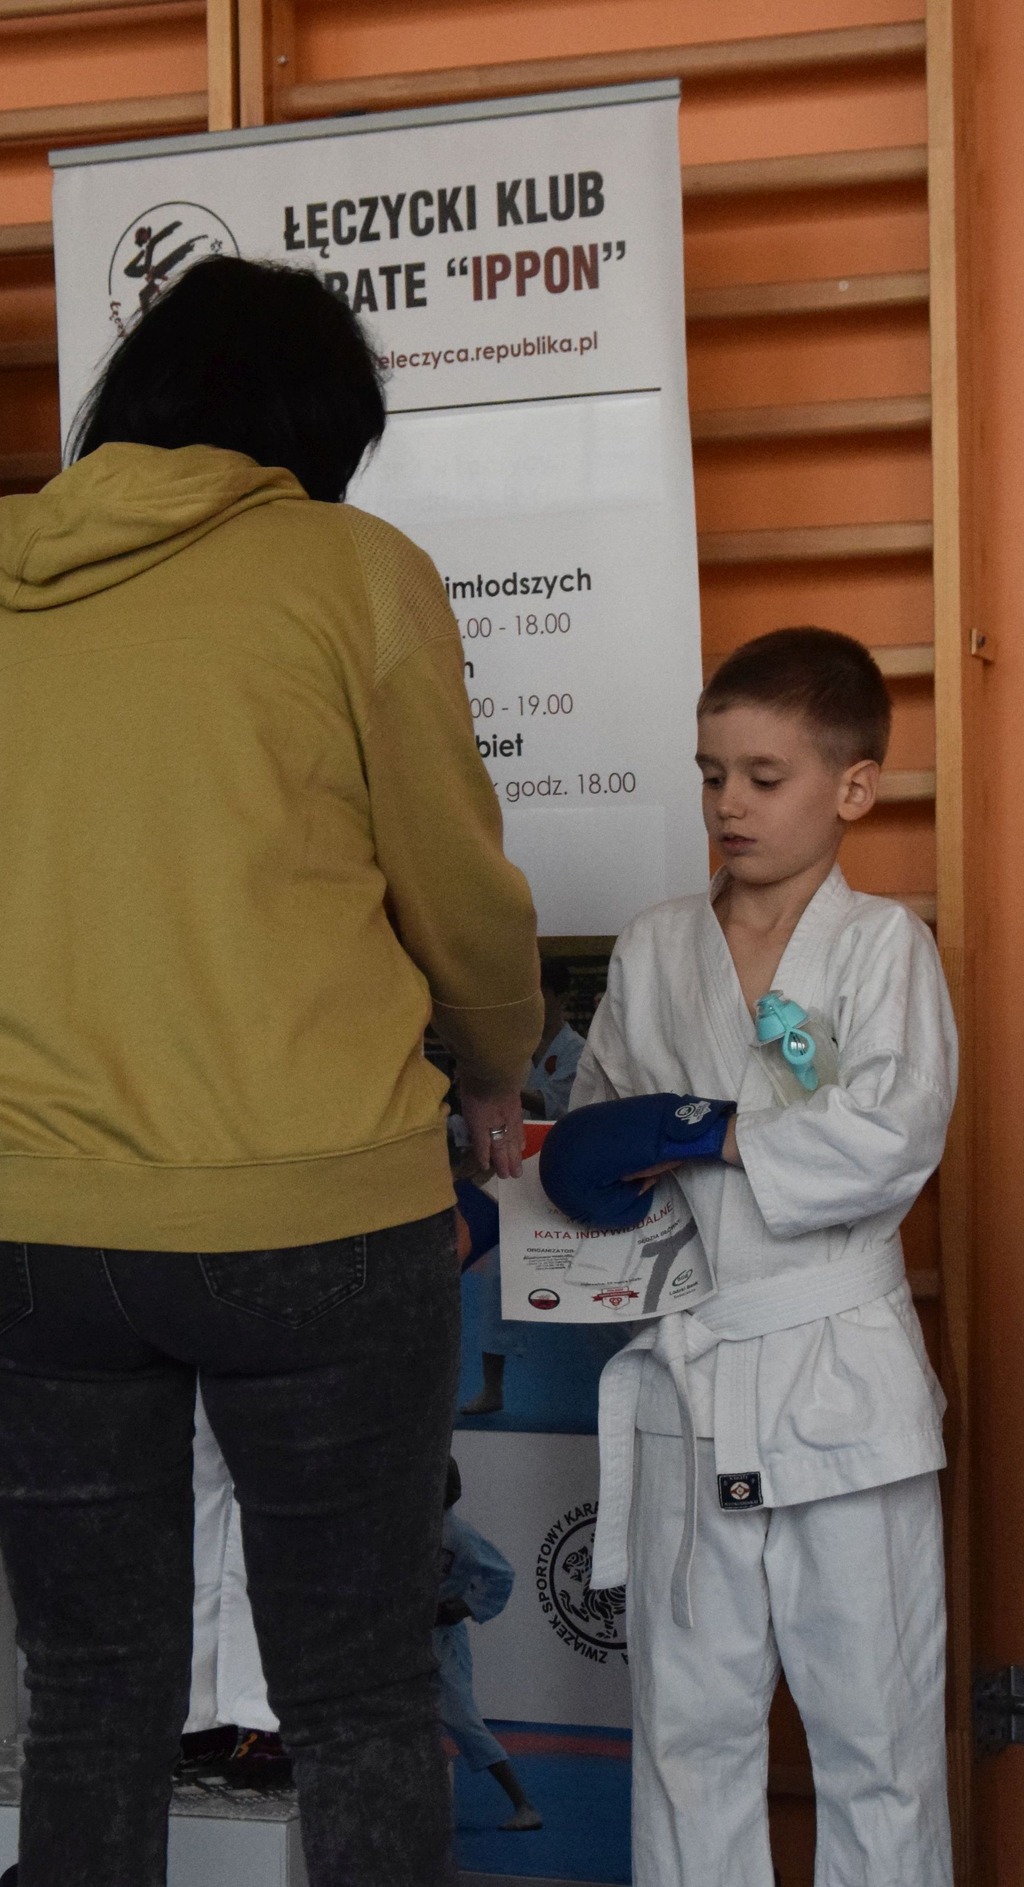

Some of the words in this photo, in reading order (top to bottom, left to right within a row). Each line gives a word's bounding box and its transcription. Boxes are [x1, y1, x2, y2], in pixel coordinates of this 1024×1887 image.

[284, 184, 478, 258] ŁĘCZYCKI
[497, 170, 605, 226] KLUB
[445, 567, 592, 600] imłodszych
[458, 616, 492, 639] .00
[515, 612, 571, 636] 18.00
[518, 694, 574, 716] 19.00
[506, 775, 568, 803] godz.
[577, 772, 636, 795] 18.00
[535, 1230, 571, 1240] KATA
[536, 1520, 564, 1614] SPORTOWY
